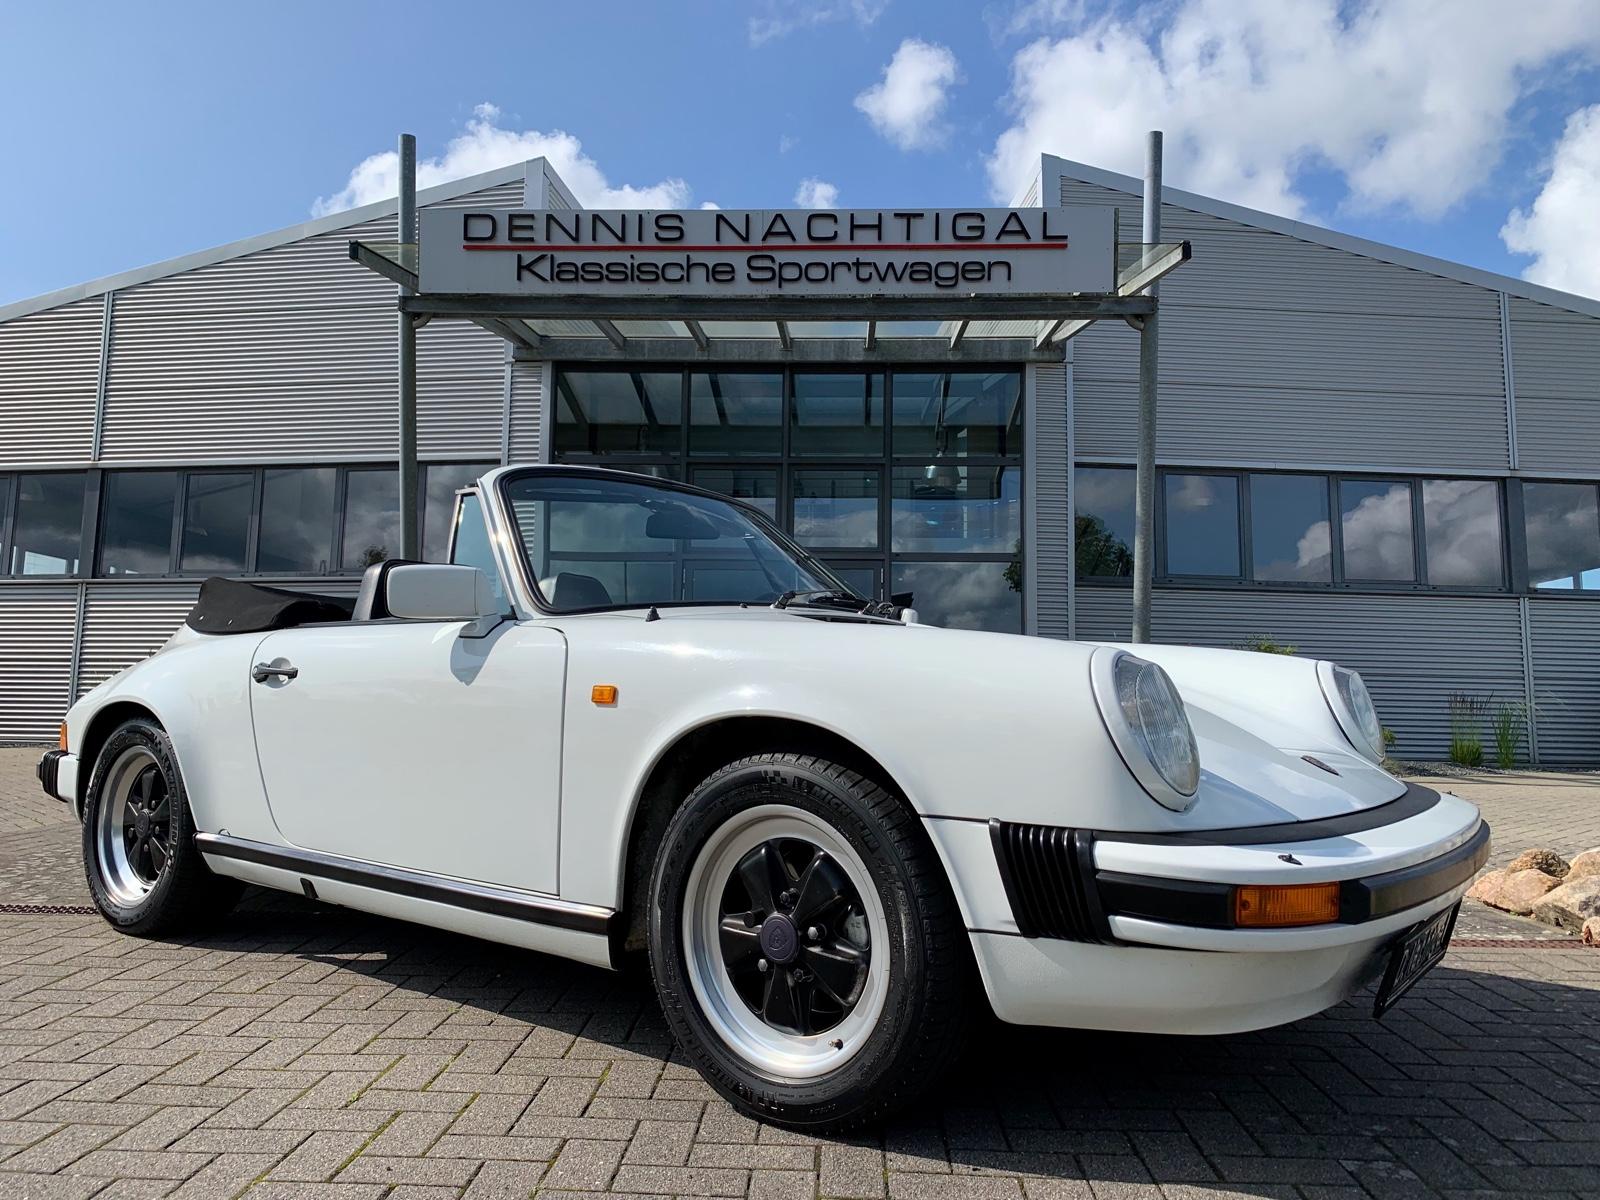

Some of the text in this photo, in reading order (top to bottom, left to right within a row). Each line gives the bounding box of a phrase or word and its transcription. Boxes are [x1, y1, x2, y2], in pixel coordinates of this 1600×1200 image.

[463, 211, 1069, 242] DENNIS NACHTIGAL
[516, 253, 1012, 289] Klassische Sportwagen
